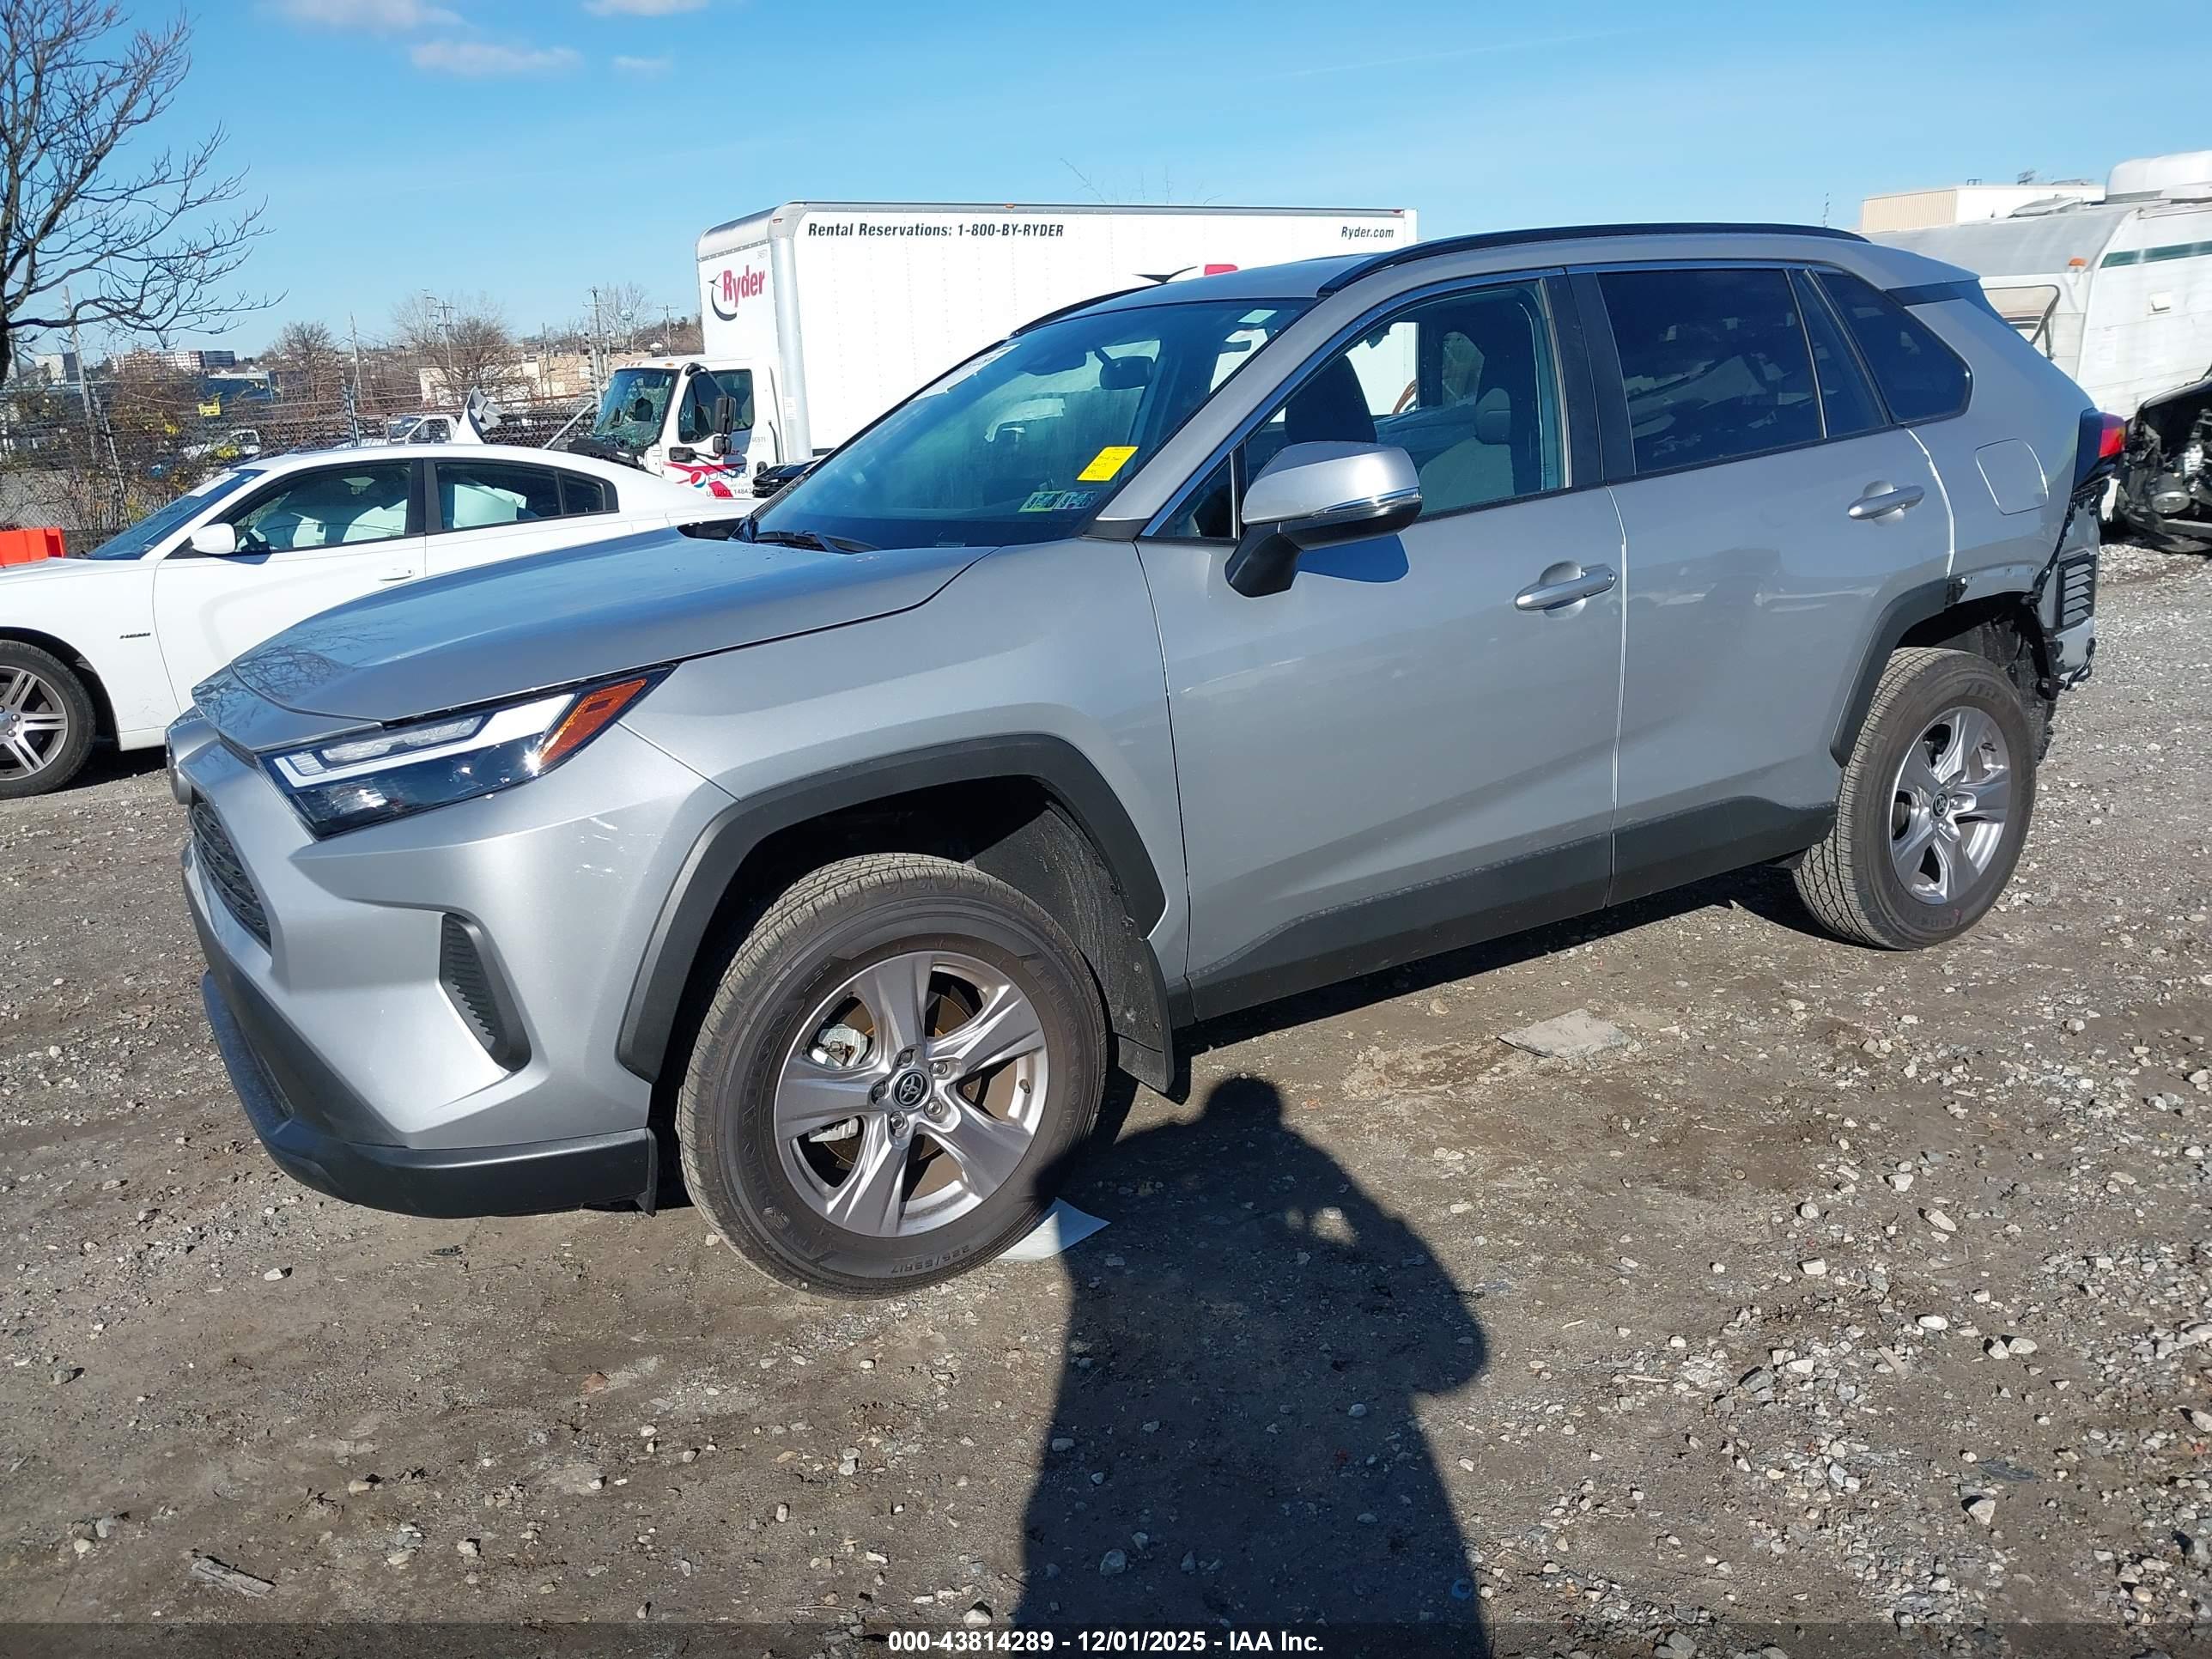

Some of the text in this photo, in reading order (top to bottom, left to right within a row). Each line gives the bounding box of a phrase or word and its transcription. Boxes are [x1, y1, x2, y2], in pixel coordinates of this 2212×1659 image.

[808, 222, 1064, 237] Rental Reservations: 1-800-BY-RYDER
[1341, 226, 1395, 240] Ryder.com
[723, 264, 765, 308] Ryder
